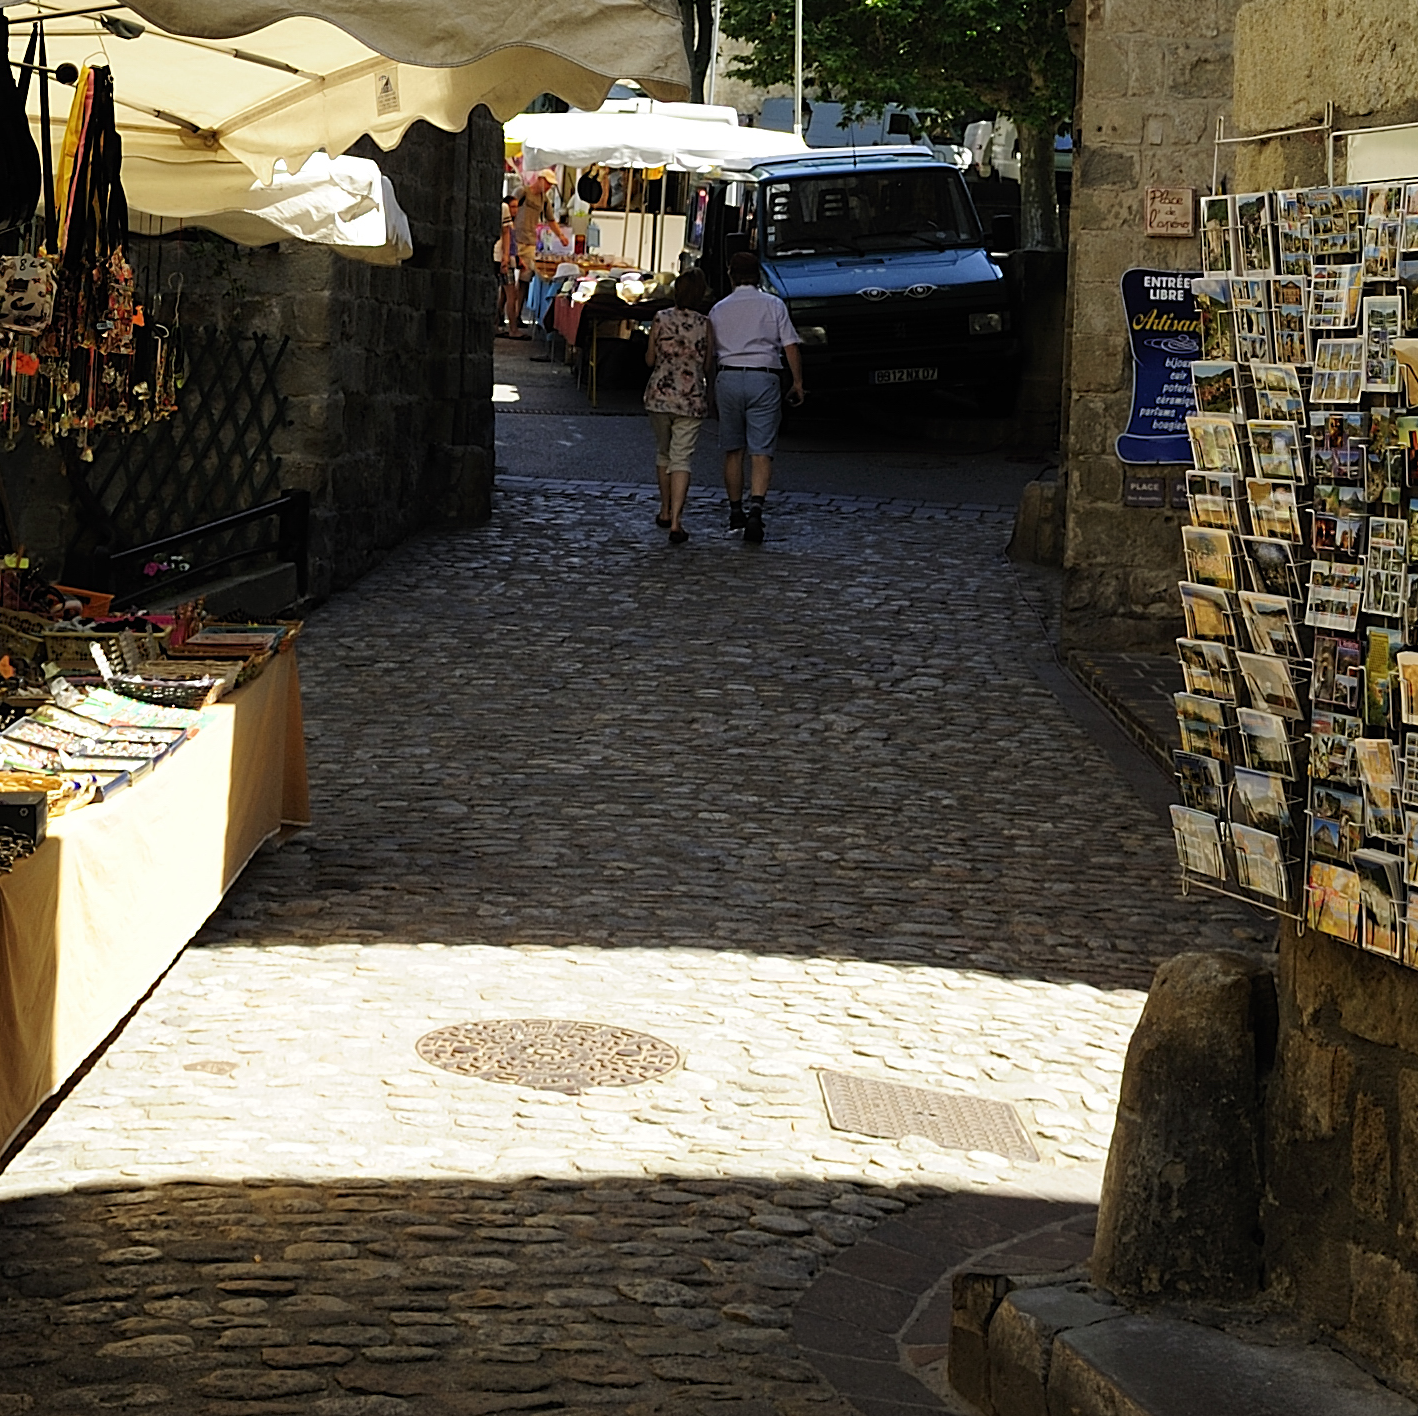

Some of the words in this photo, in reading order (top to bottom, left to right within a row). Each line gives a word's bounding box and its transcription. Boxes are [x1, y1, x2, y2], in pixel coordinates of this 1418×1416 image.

[1150, 189, 1184, 207] Place
[1165, 206, 1176, 216] de
[1144, 274, 1191, 289] ENTRÉE
[1149, 289, 1184, 301] LIBRE
[1133, 308, 1198, 331] Artisan
[1165, 356, 1191, 369] bijou
[1155, 395, 1195, 408] céramiqu
